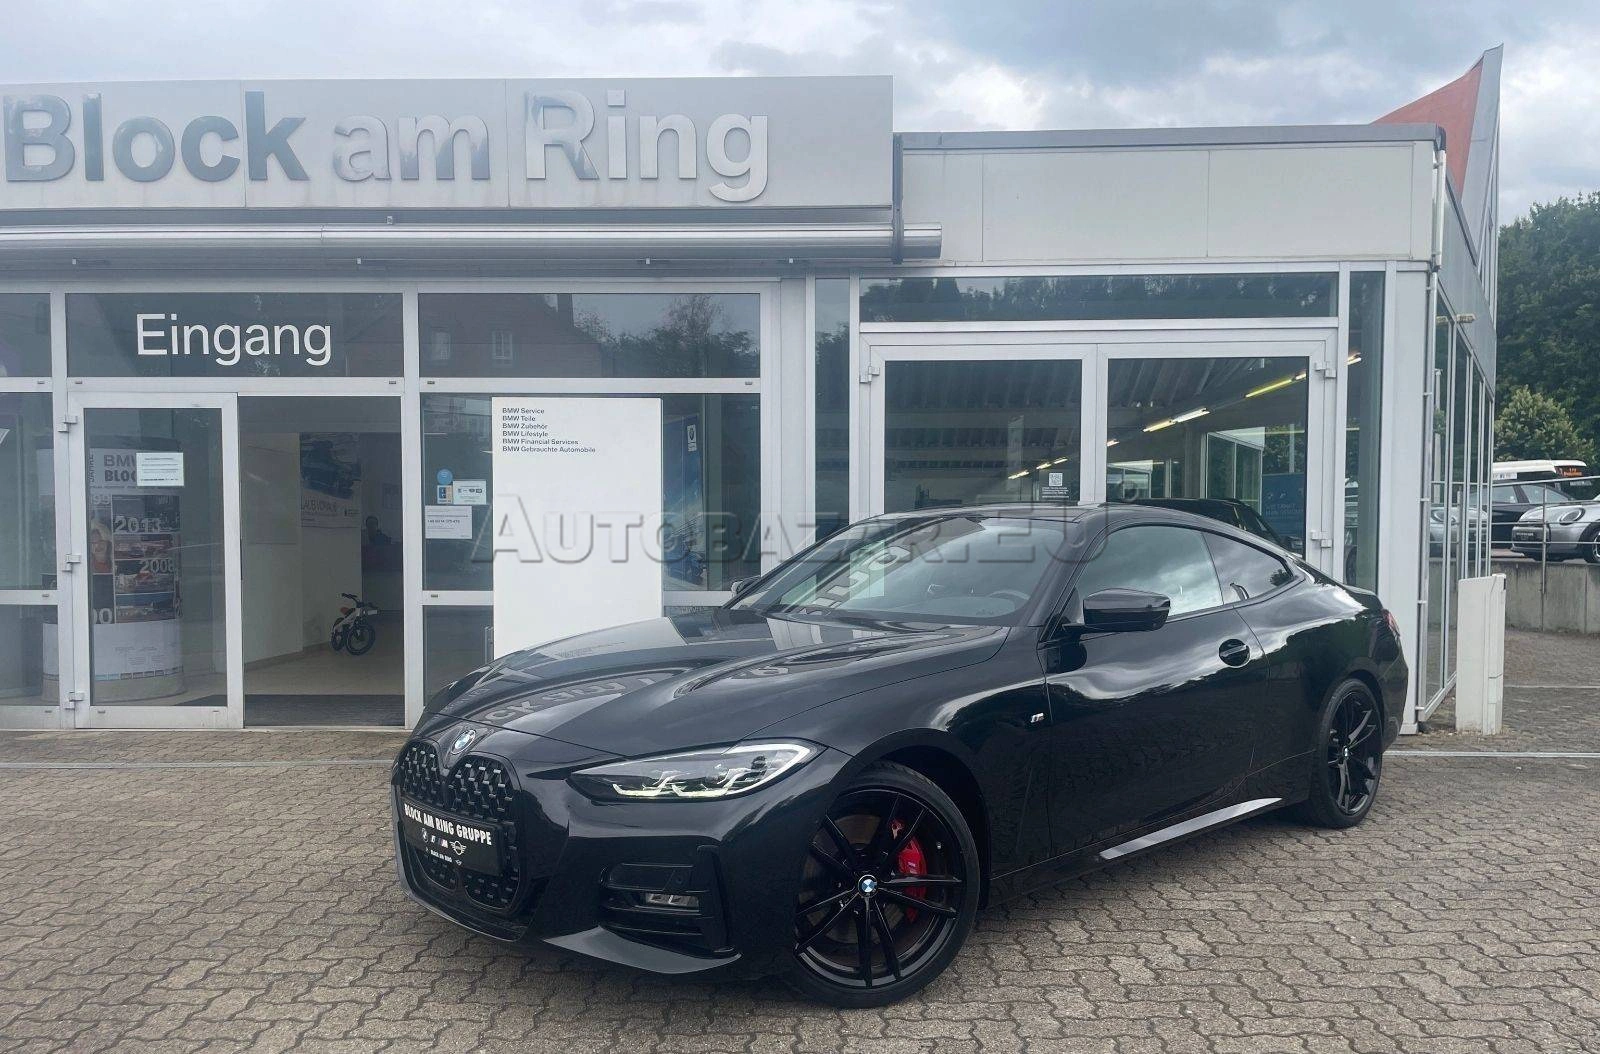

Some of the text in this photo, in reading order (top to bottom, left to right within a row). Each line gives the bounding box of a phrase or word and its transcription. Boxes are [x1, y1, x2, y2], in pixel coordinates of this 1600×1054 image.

[4, 89, 769, 202] Block am Ring
[136, 313, 332, 366] Eingang
[502, 430, 549, 438] BMW Lifestyle
[404, 803, 493, 846] BLOCK AM RING GRUPPE
